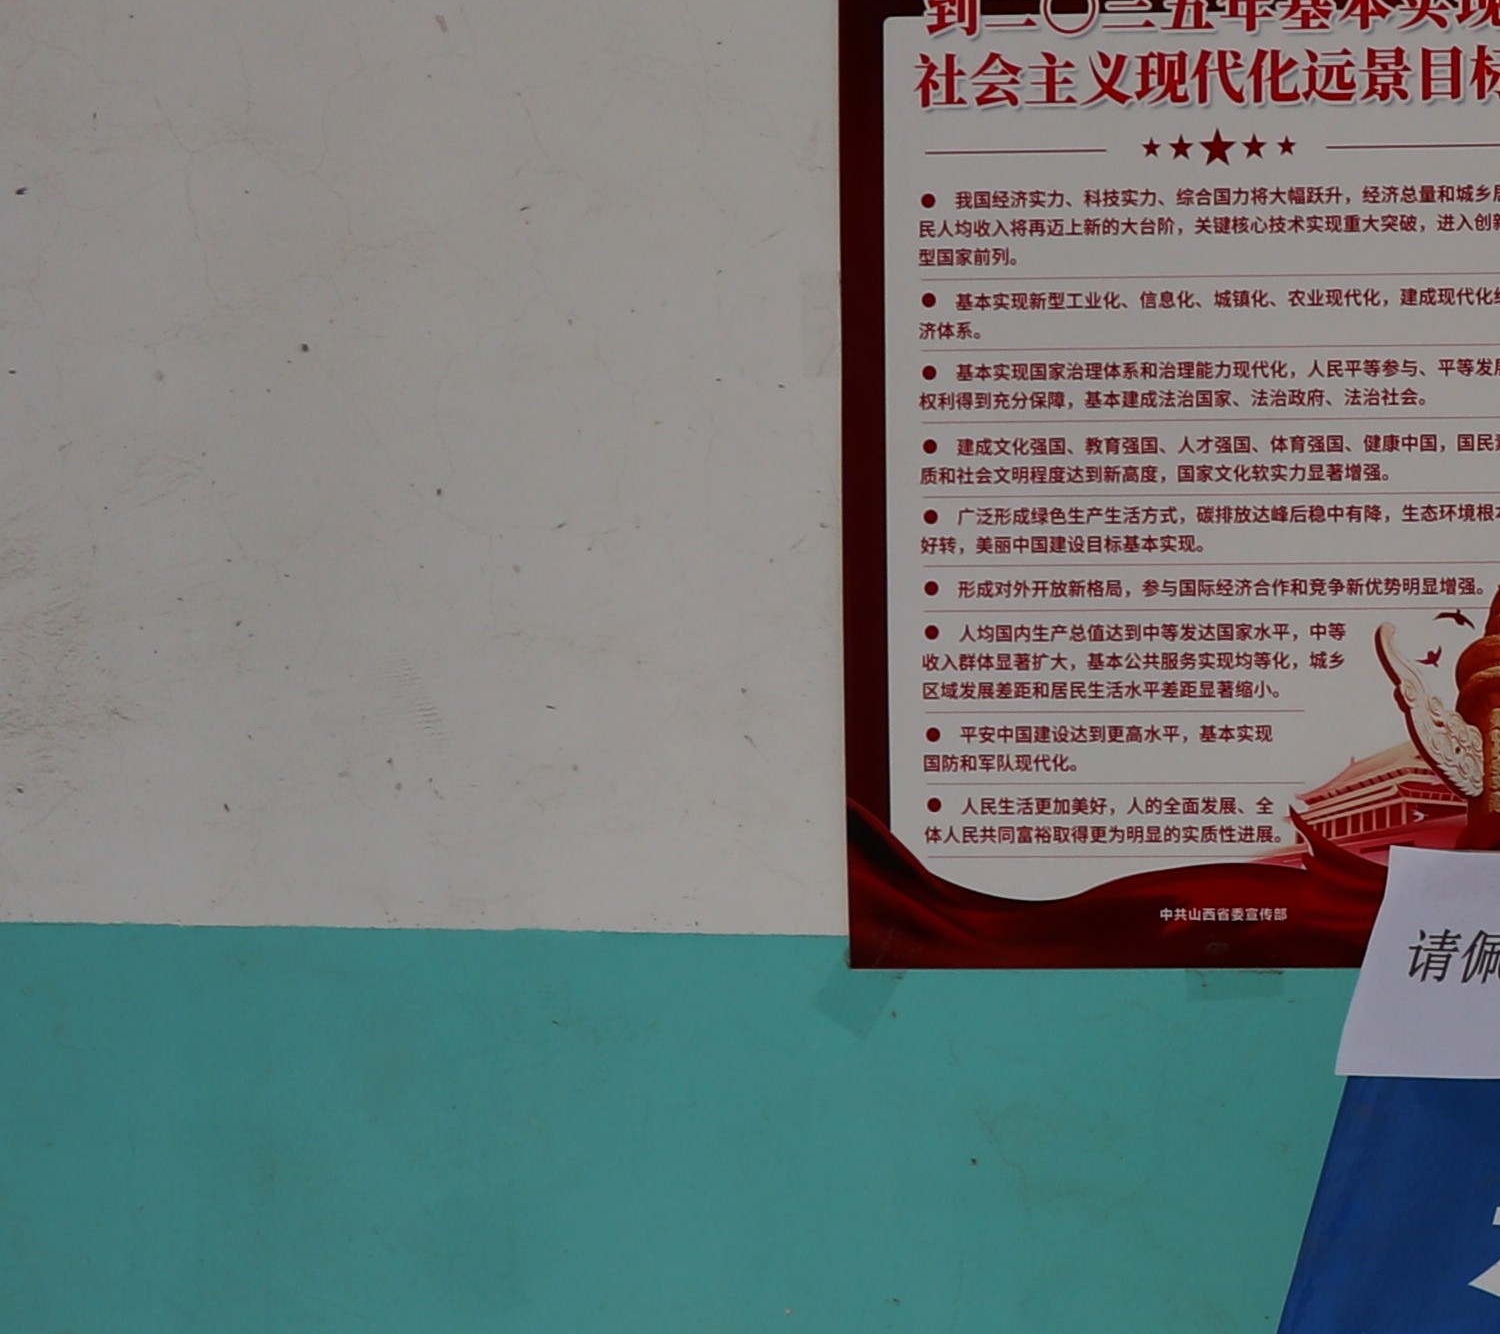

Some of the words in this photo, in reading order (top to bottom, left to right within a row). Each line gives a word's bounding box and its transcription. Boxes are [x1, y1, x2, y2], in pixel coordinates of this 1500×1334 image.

[919, 248, 1016, 266] 型国家前列。
[919, 322, 980, 339] 济体系。
[921, 535, 1203, 554] 好转，美丽中国建设目标基本实现。
[960, 725, 1272, 744] 平安中国建设达到更高水平，基本实现
[924, 754, 1076, 772] 国防和军队现代化。
[963, 797, 1273, 815] 人民生活更加美好，人的全面发展、全
[925, 826, 1281, 843] 体人民共同富裕取得更为明显的实质性进展。
[1160, 908, 1287, 921] 中共山西省委宣传部
